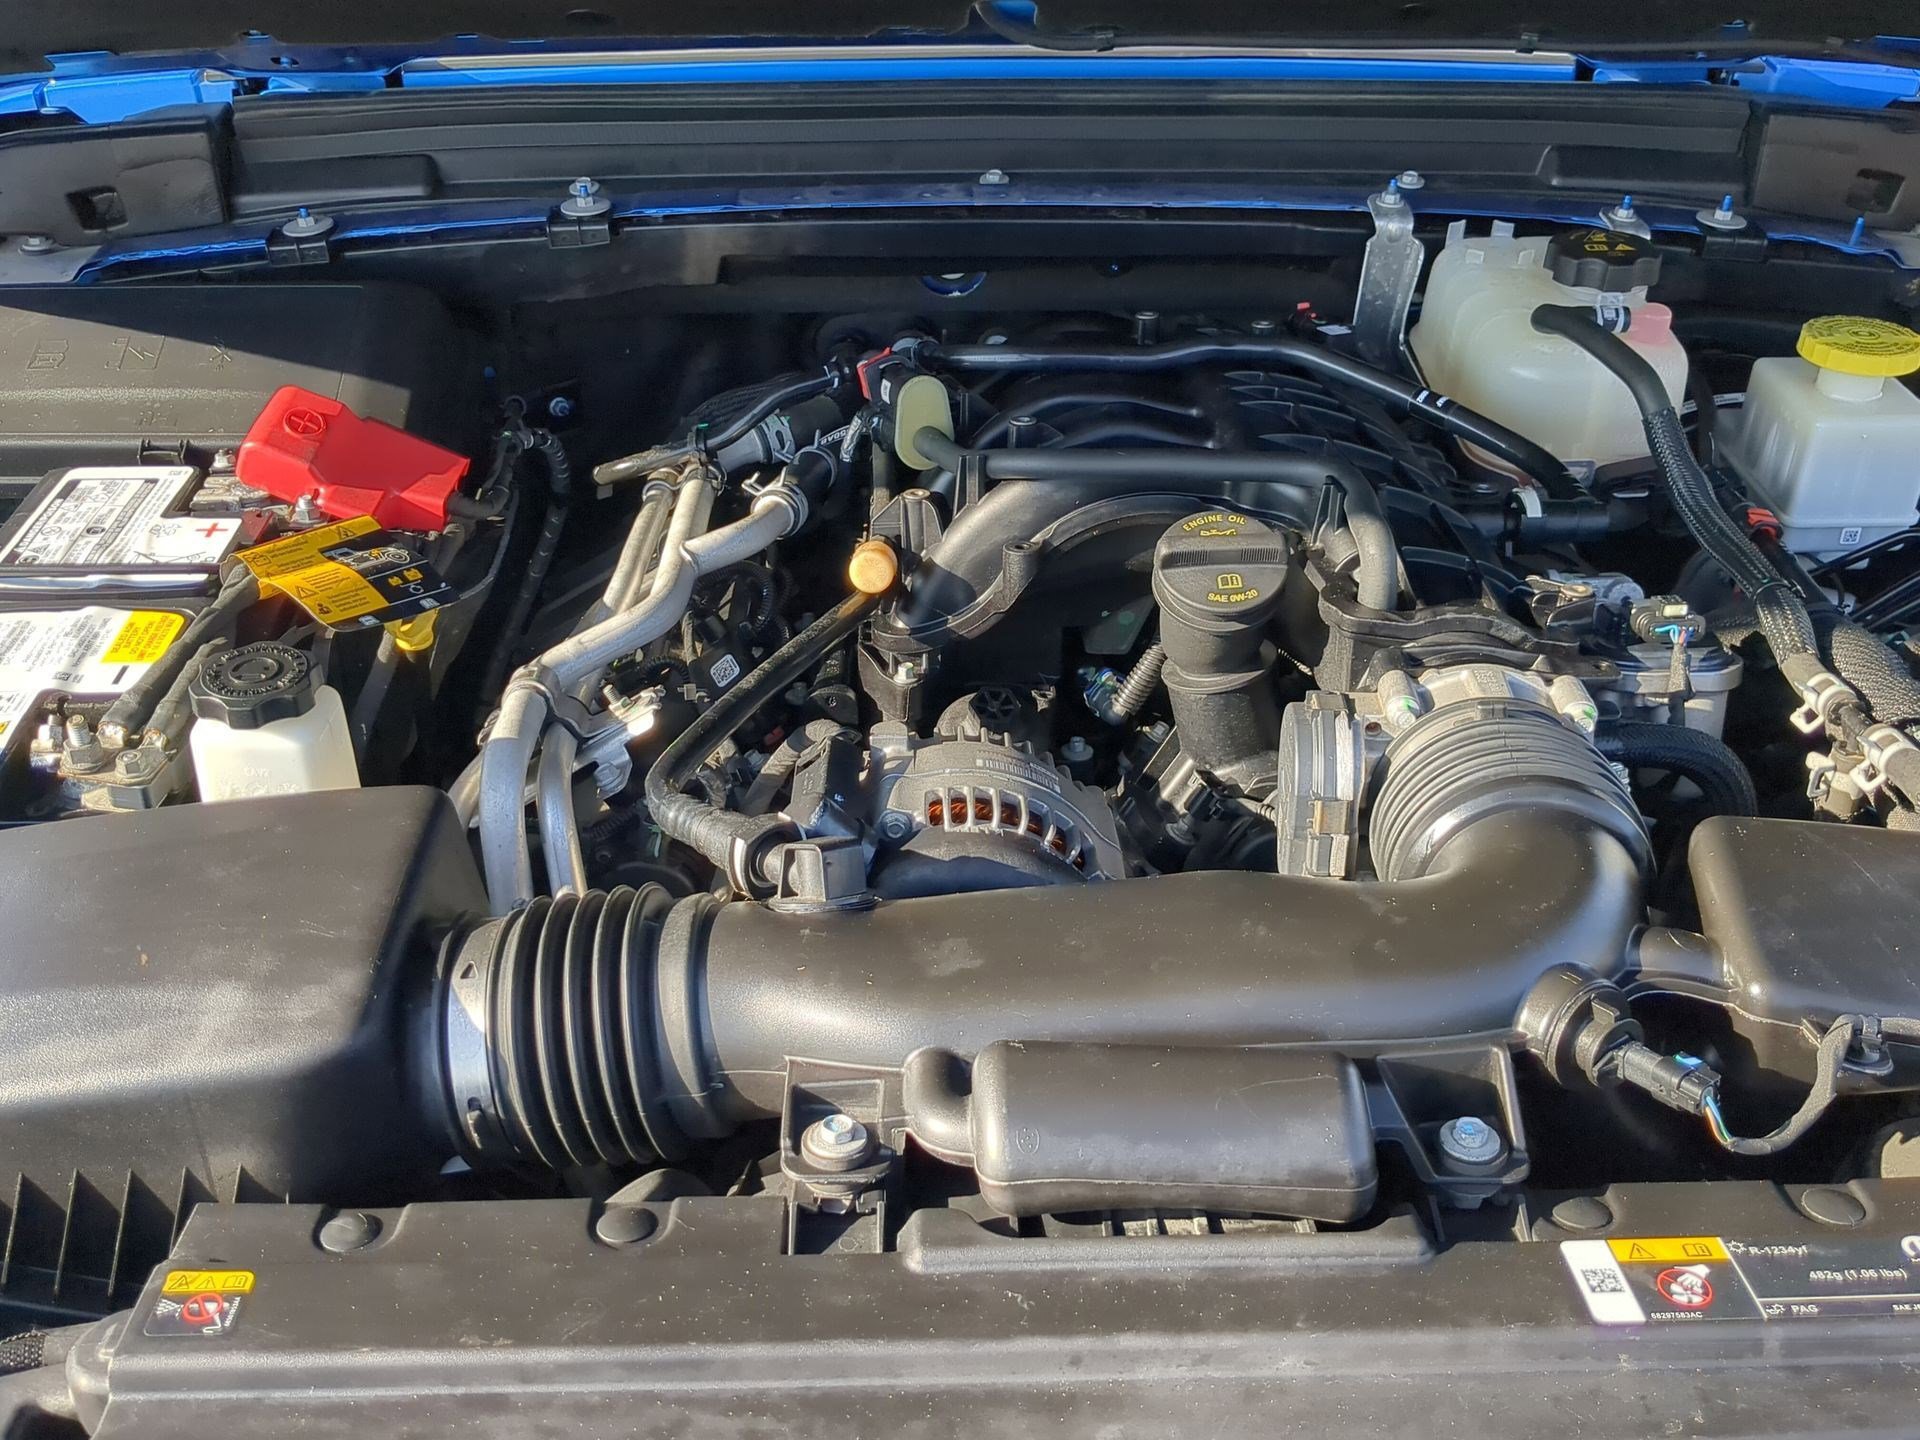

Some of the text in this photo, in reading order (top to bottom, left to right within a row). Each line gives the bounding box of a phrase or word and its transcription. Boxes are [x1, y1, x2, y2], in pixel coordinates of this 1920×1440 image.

[820, 429, 849, 446] 50AB
[1182, 514, 1247, 532] ENGINE OIL
[1207, 588, 1258, 603] SAE 0W-20
[1749, 1244, 1809, 1258] R-1234yf
[1809, 1268, 1908, 1281] 482g (1.06 lbs)
[1791, 1304, 1819, 1314] PAG
